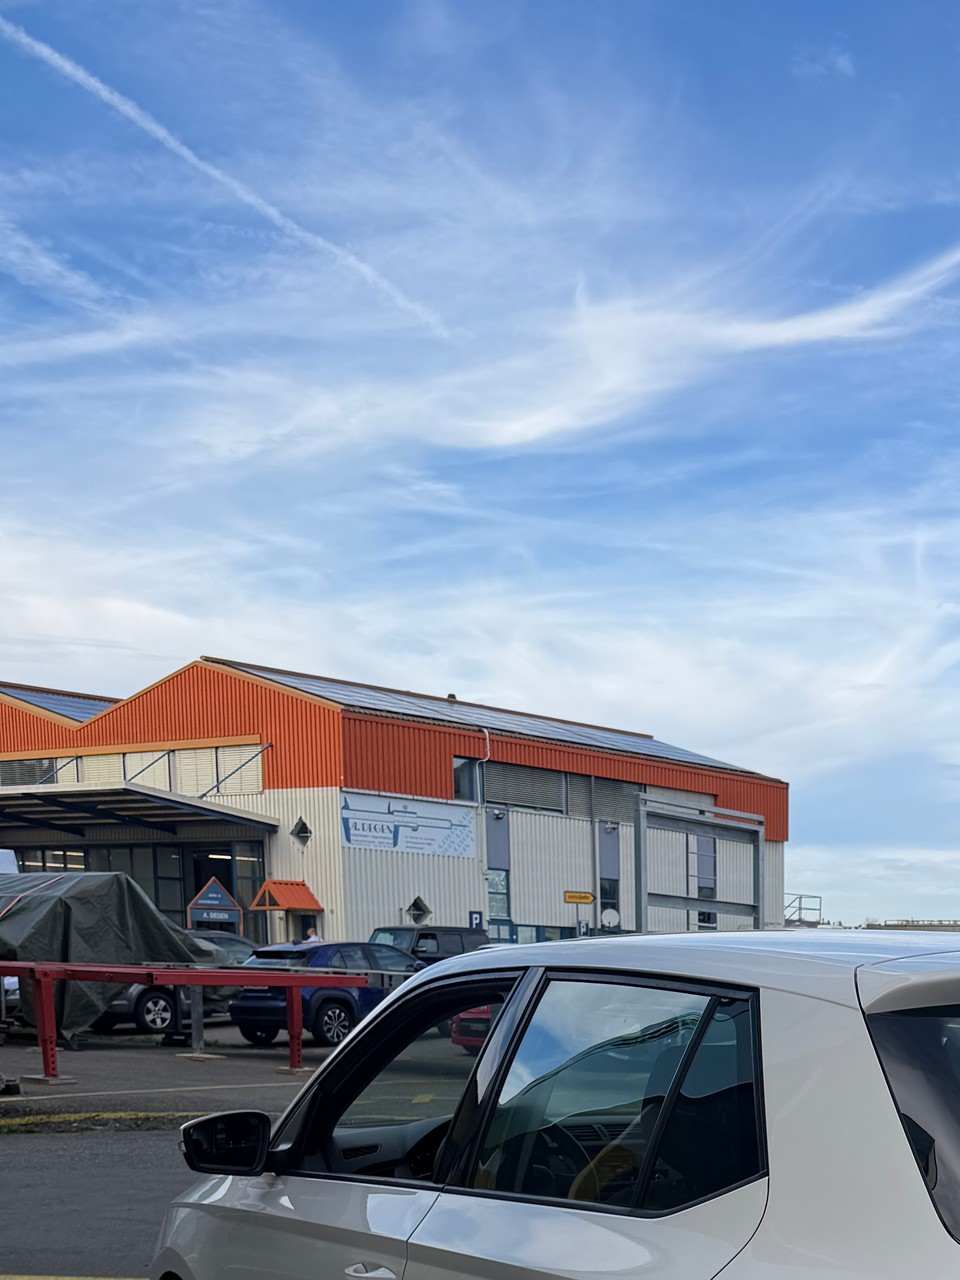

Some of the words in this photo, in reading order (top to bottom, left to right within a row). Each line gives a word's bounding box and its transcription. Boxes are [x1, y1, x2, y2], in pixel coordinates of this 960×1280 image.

[361, 822, 393, 834] DEGEN
[472, 913, 480, 929] P
[580, 923, 587, 936] P
